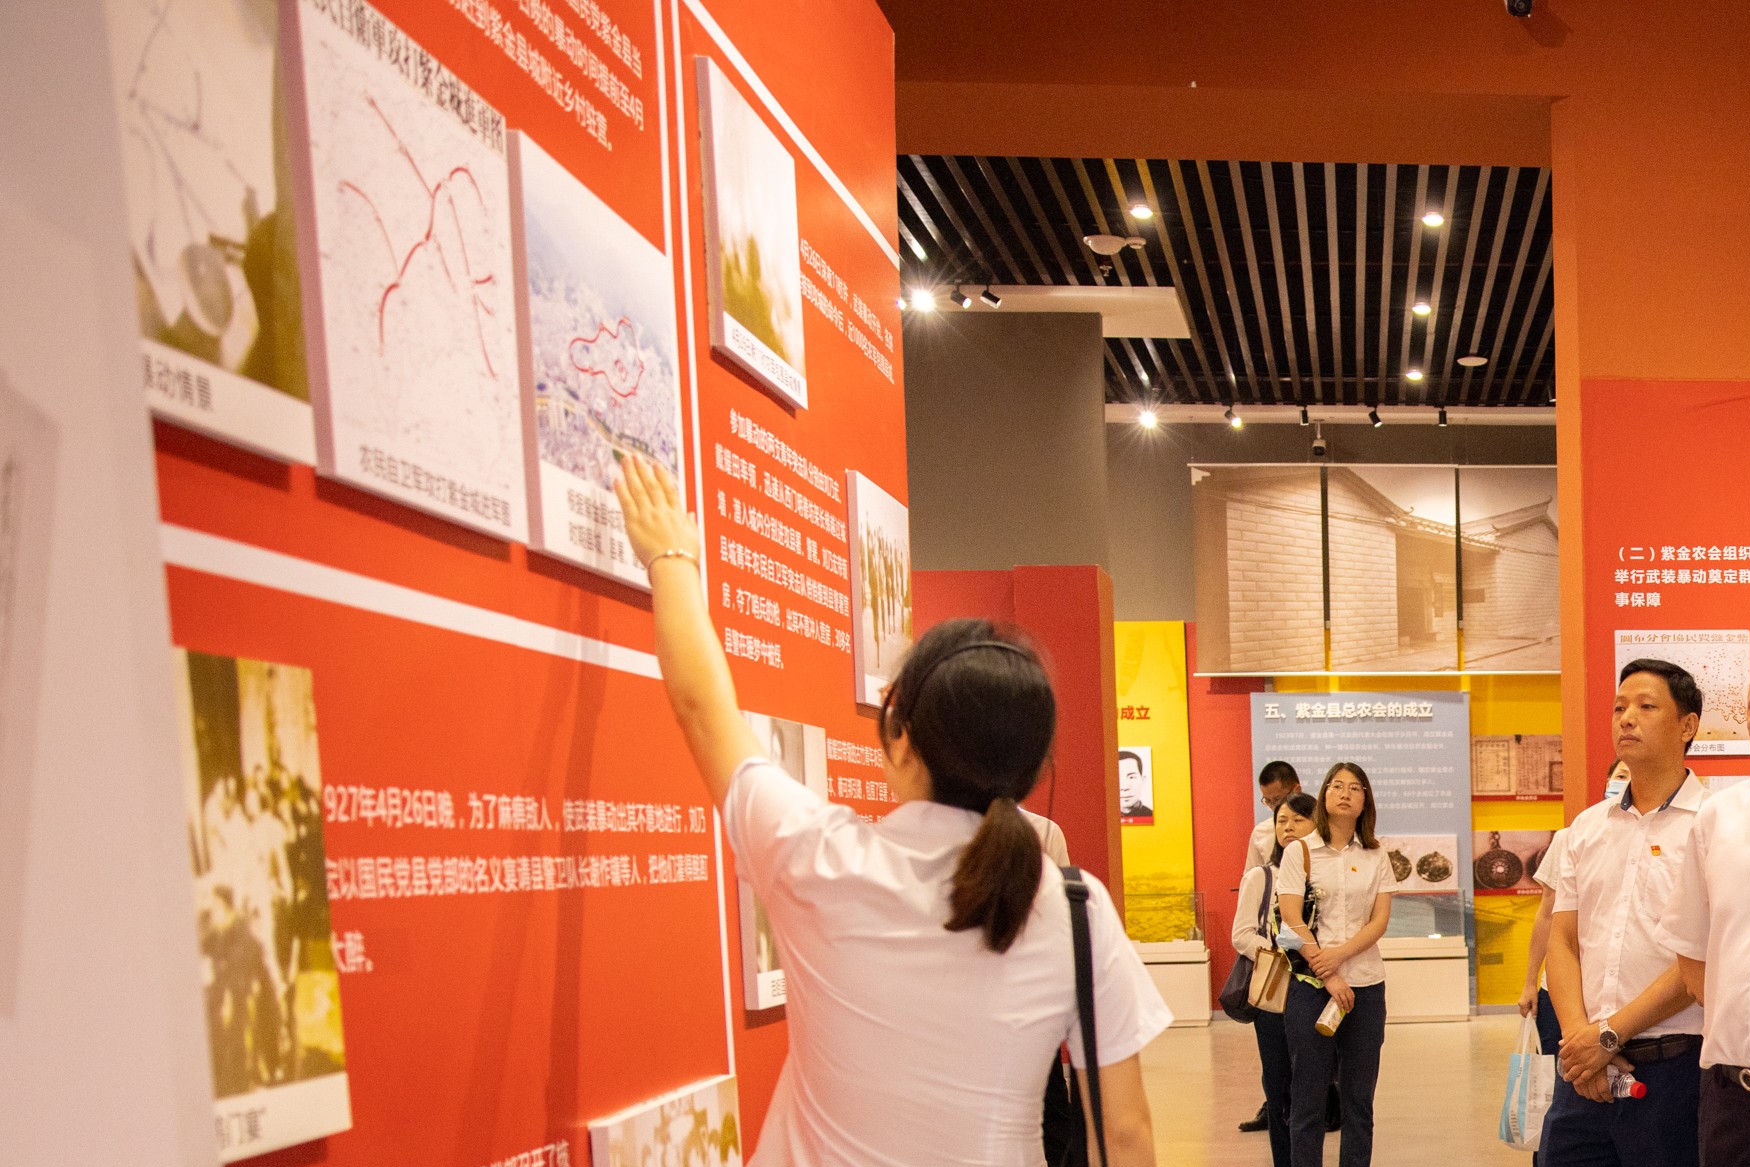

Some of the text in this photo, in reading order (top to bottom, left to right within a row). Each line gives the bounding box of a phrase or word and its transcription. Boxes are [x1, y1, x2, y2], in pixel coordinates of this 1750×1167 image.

[1614, 592, 1662, 607] 事保障
[1116, 705, 1150, 720] 成立
[1264, 701, 1433, 719] 五、紫金县总农会的成立
